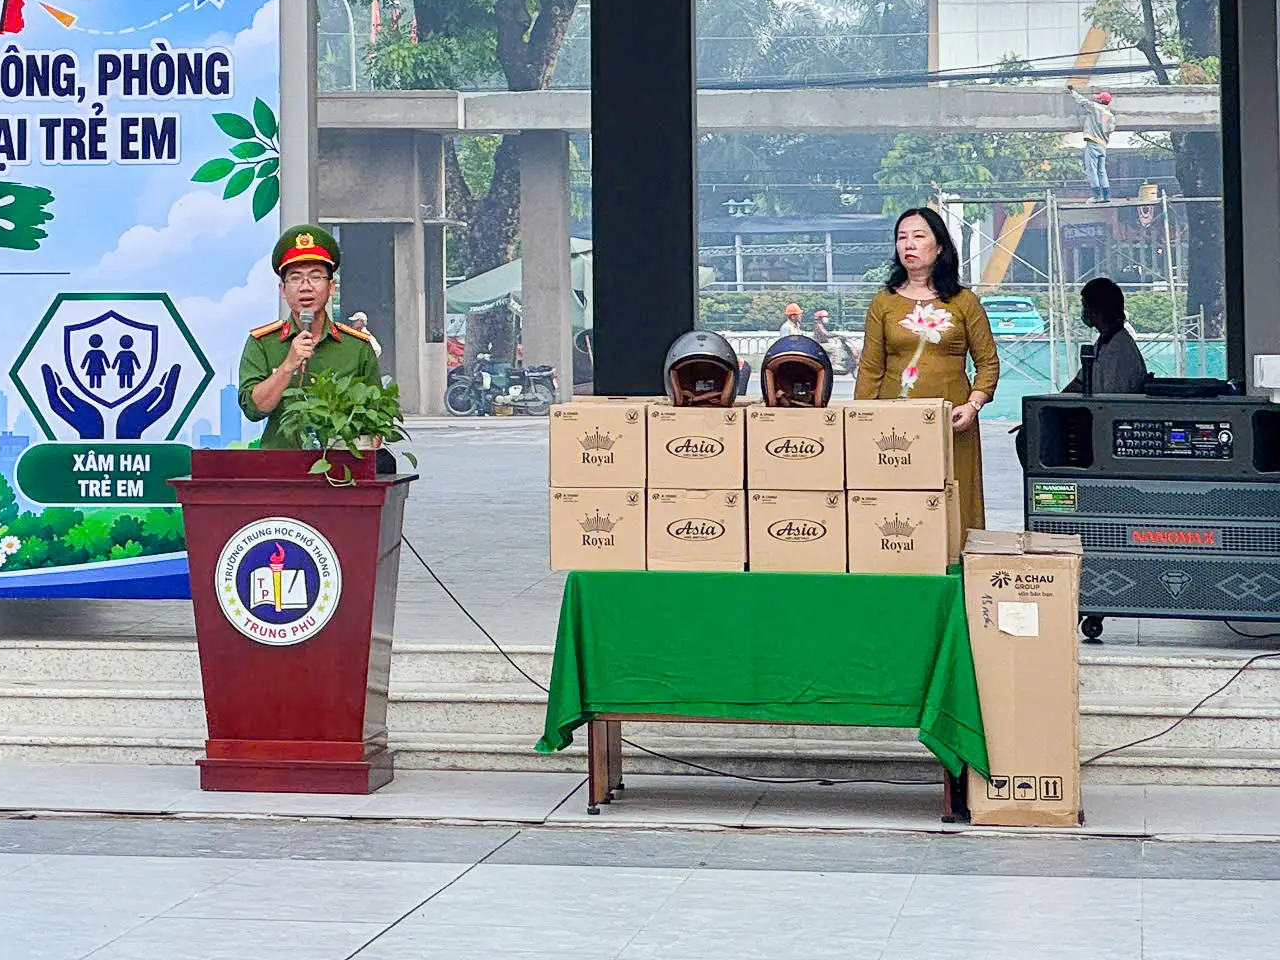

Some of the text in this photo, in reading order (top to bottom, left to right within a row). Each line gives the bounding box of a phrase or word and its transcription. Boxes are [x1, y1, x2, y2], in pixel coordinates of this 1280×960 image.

[98, 39, 231, 97] PHÒNG
[39, 103, 108, 161] TRẺ
[120, 116, 177, 160] EM
[675, 438, 716, 455] Asia
[774, 439, 816, 455] Asia
[72, 449, 151, 478] XÂM HẠI
[581, 452, 614, 467] Royal
[878, 453, 912, 467] Royal
[77, 472, 145, 498] TRẺ EM
[675, 521, 716, 537] Asia
[776, 521, 818, 537] Asia
[1131, 528, 1216, 545] NANOMAX
[582, 534, 615, 549] Royal
[880, 538, 914, 553] Royal
[224, 545, 244, 582] TRƯỜNG
[242, 527, 272, 546] TRUNG
[274, 527, 293, 538] HỌC
[311, 546, 330, 578] THÔNG
[1014, 574, 1054, 583] A CHAU
[243, 615, 317, 639] TRUNG PHÚ
